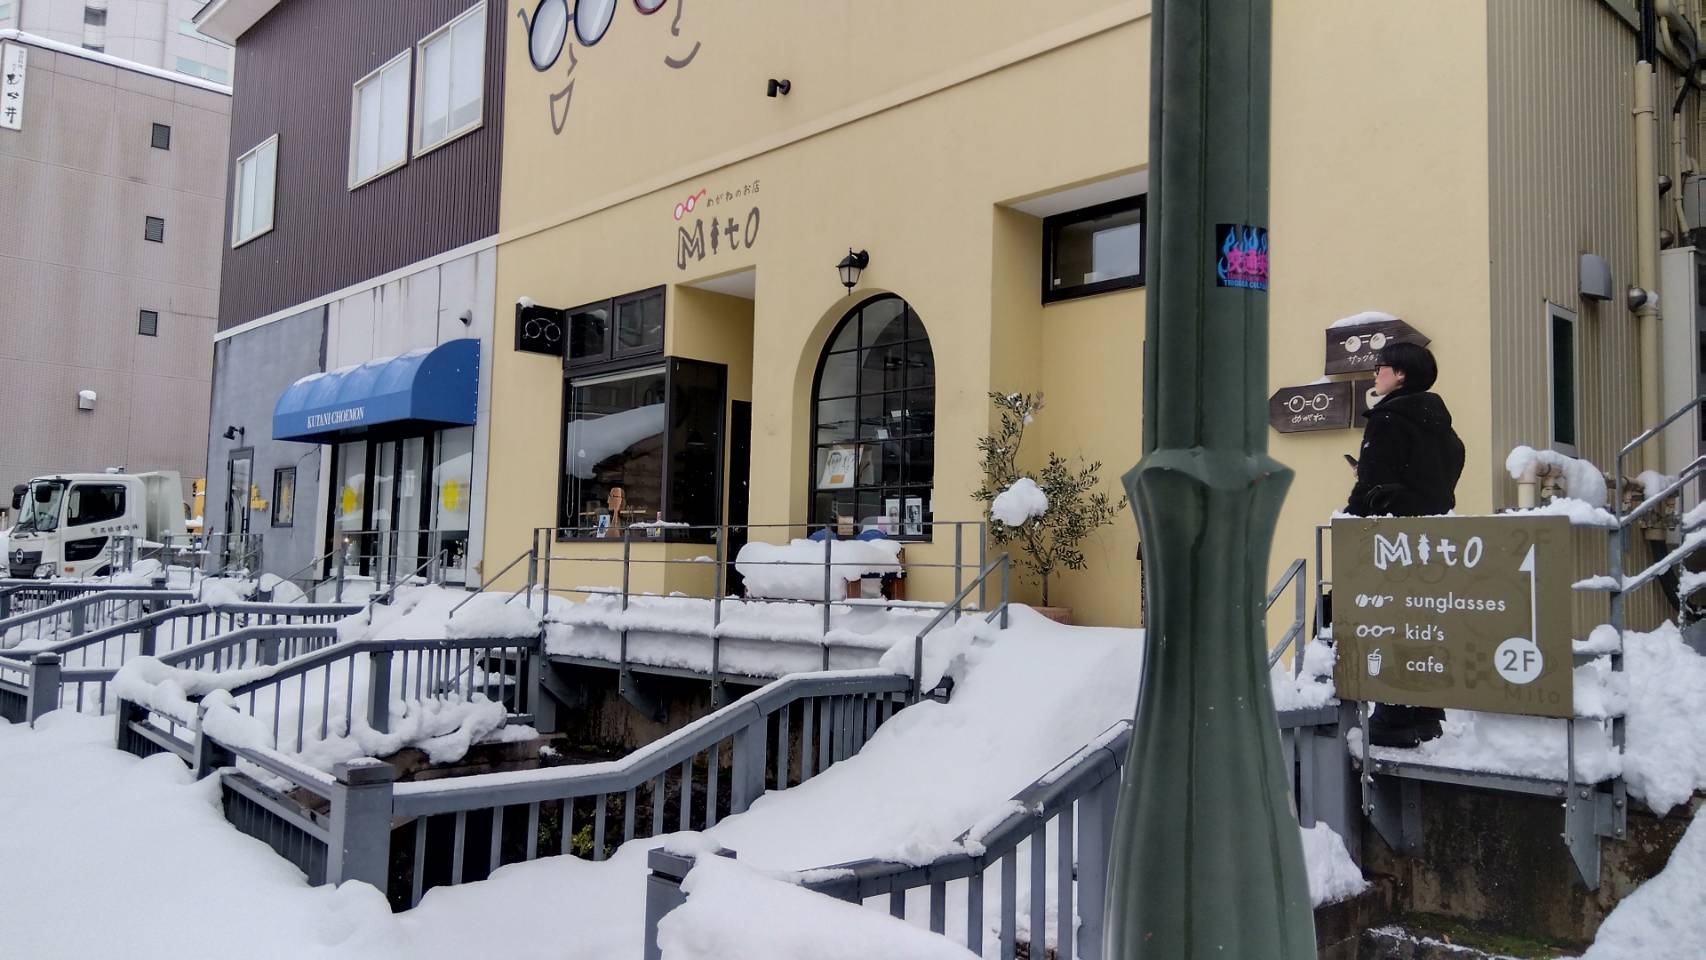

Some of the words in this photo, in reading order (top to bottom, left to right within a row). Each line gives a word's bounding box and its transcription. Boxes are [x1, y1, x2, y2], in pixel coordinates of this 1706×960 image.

[706, 179, 760, 208] めがねのお店
[307, 412, 331, 429] KUTANI
[331, 406, 365, 424] CHOEMON
[1291, 413, 1326, 424] めがね
[1405, 591, 1506, 613] sunglasses
[1405, 623, 1444, 641] kid's
[1406, 656, 1444, 673] cafe
[1502, 649, 1536, 673] 2F
